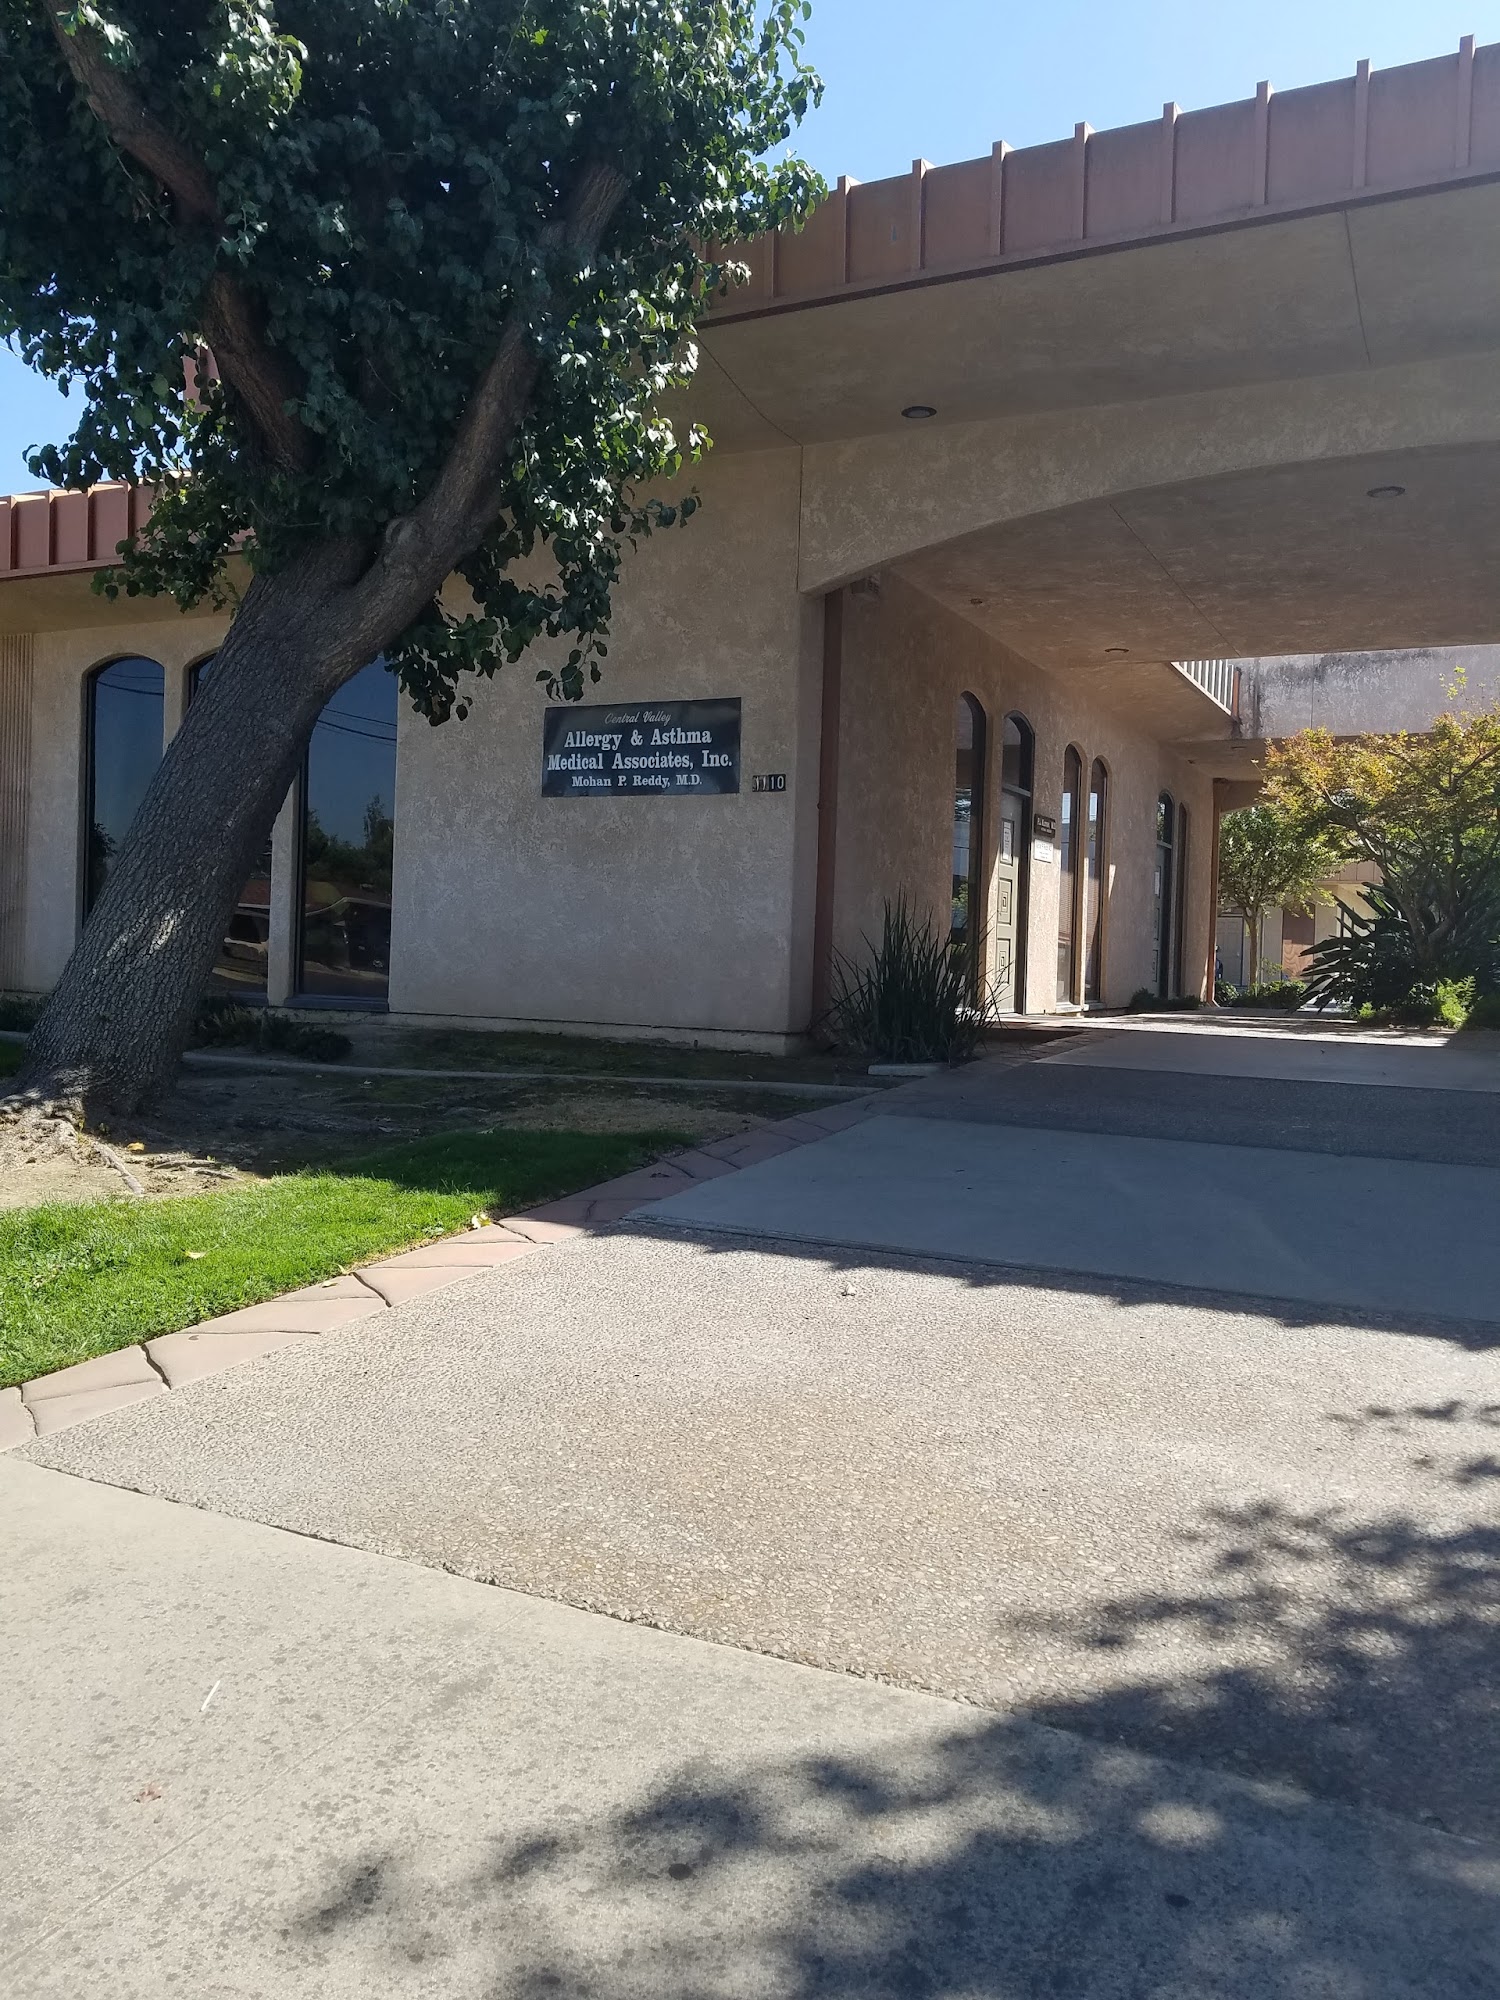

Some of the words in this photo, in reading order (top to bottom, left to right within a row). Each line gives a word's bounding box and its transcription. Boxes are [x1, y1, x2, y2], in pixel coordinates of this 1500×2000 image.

[605, 712, 639, 724] Central
[643, 711, 671, 726] Valley
[564, 731, 622, 750] Allergy
[631, 729, 643, 746] &
[650, 728, 712, 745] Asthma
[547, 753, 603, 770] Medical
[612, 751, 694, 770] Associates,
[702, 750, 732, 767] Inc.
[572, 776, 612, 787] Mohan
[618, 775, 627, 787] P.
[632, 774, 670, 788] Reddy,
[676, 774, 702, 785] M.D.
